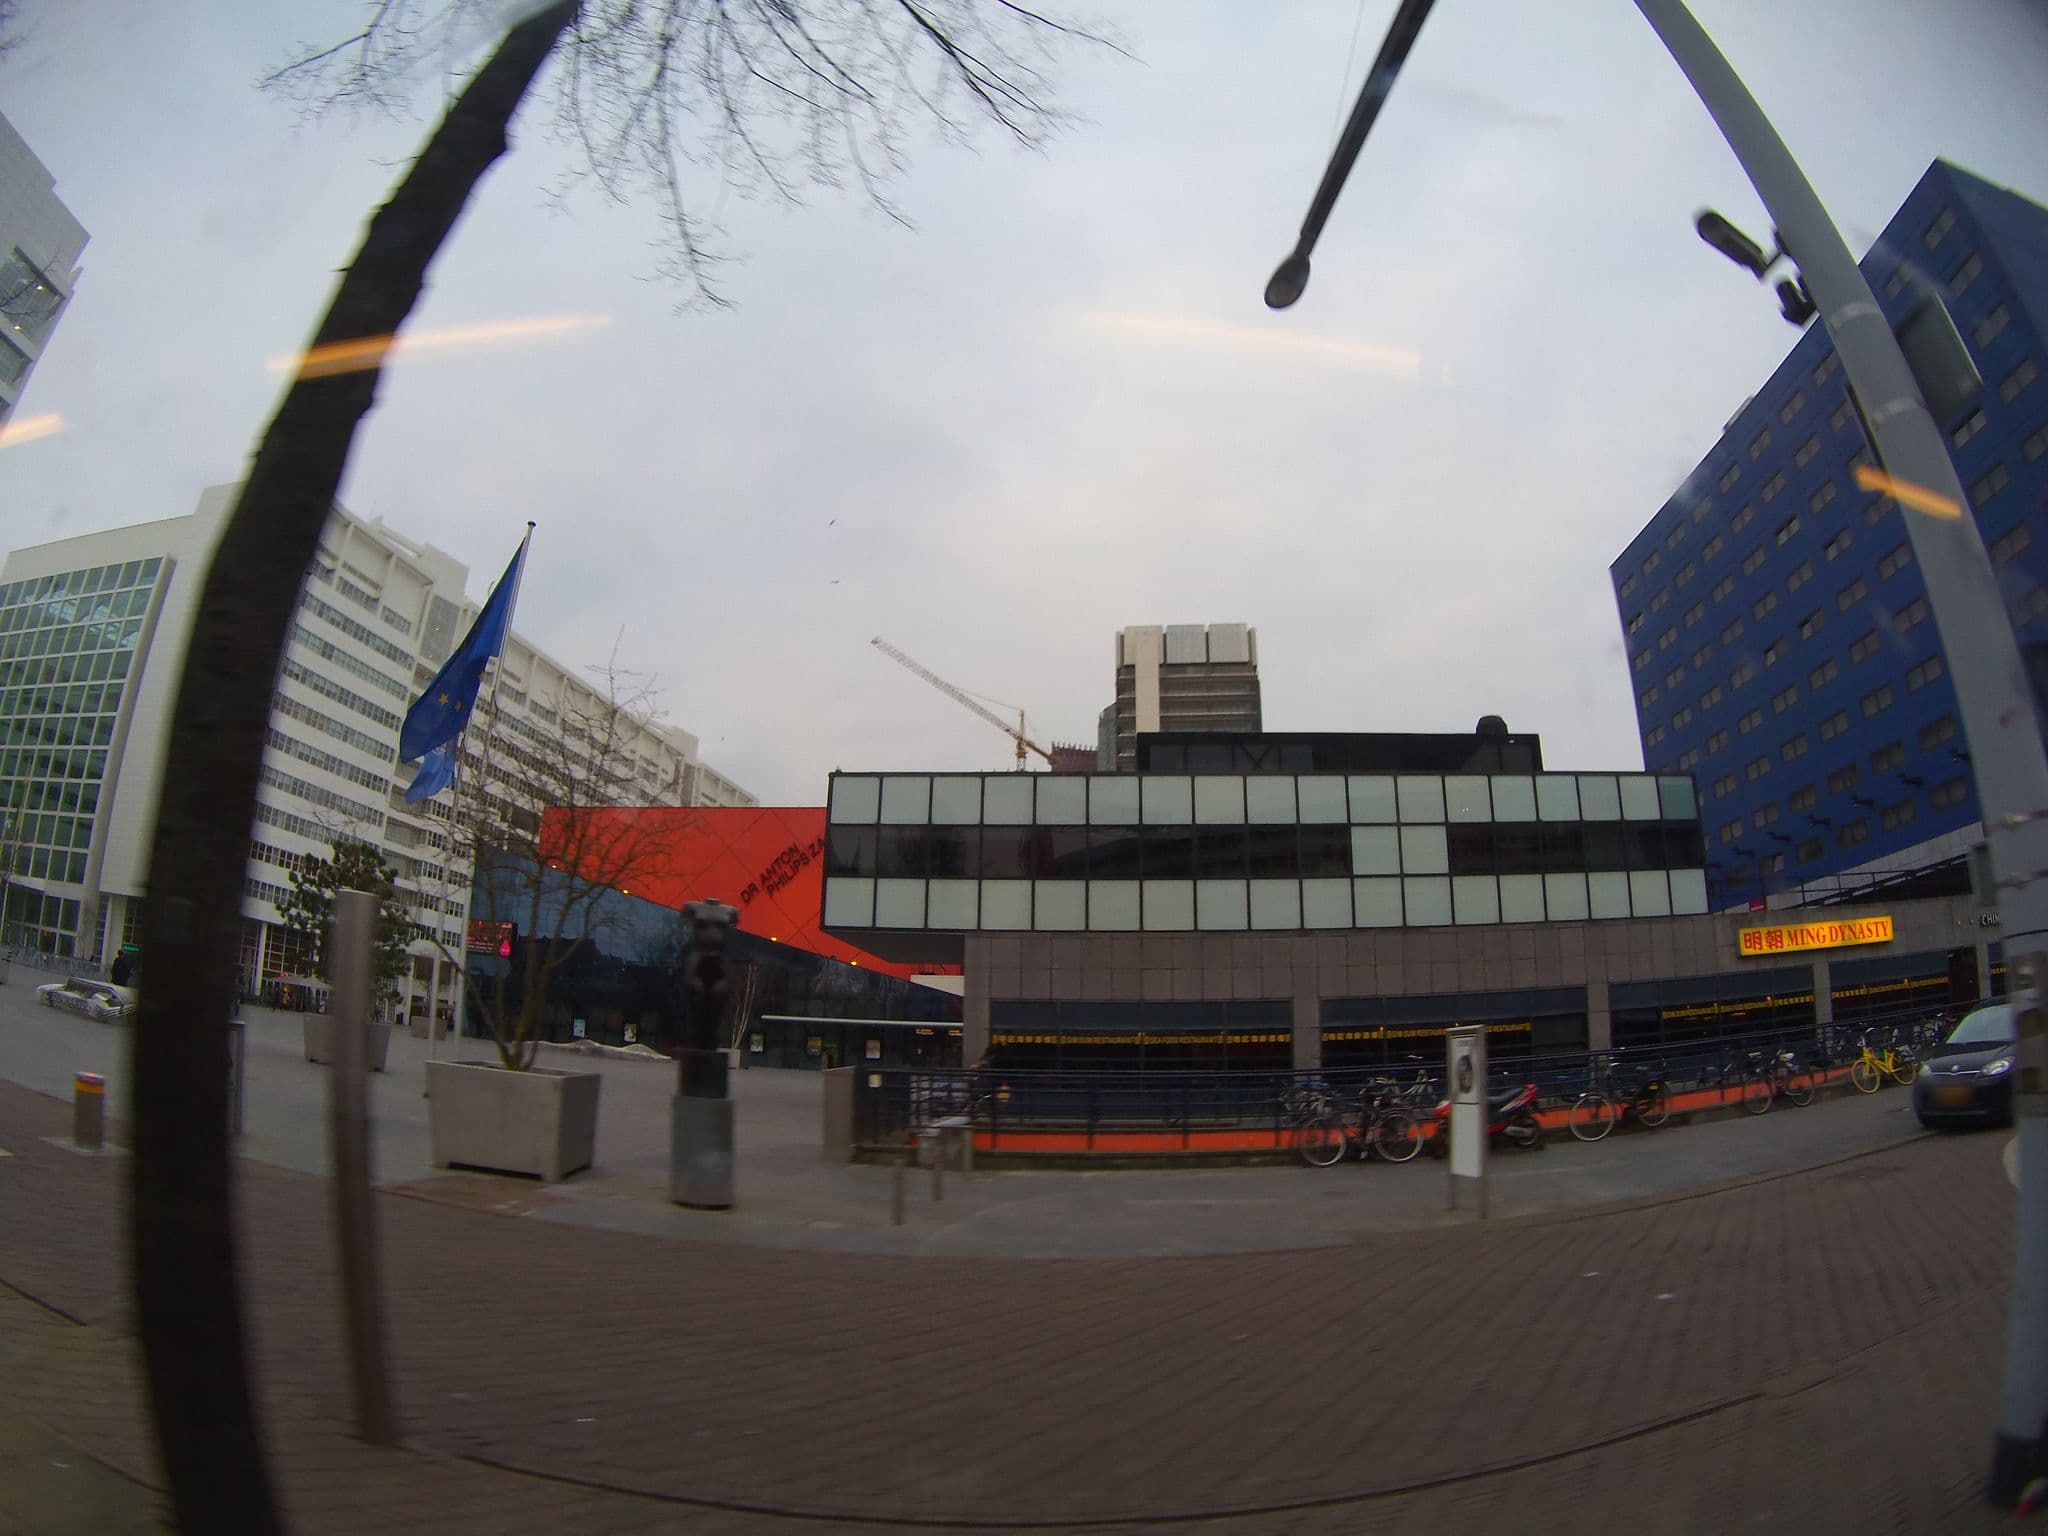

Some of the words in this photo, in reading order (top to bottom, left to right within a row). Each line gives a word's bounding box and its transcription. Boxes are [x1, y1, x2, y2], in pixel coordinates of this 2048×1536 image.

[760, 842, 801, 886] ANTON
[766, 852, 810, 897] PHILIPS
[1743, 929, 1784, 951] 明朝
[1787, 926, 1827, 948] MING
[1829, 920, 1889, 943] DYNASTY
